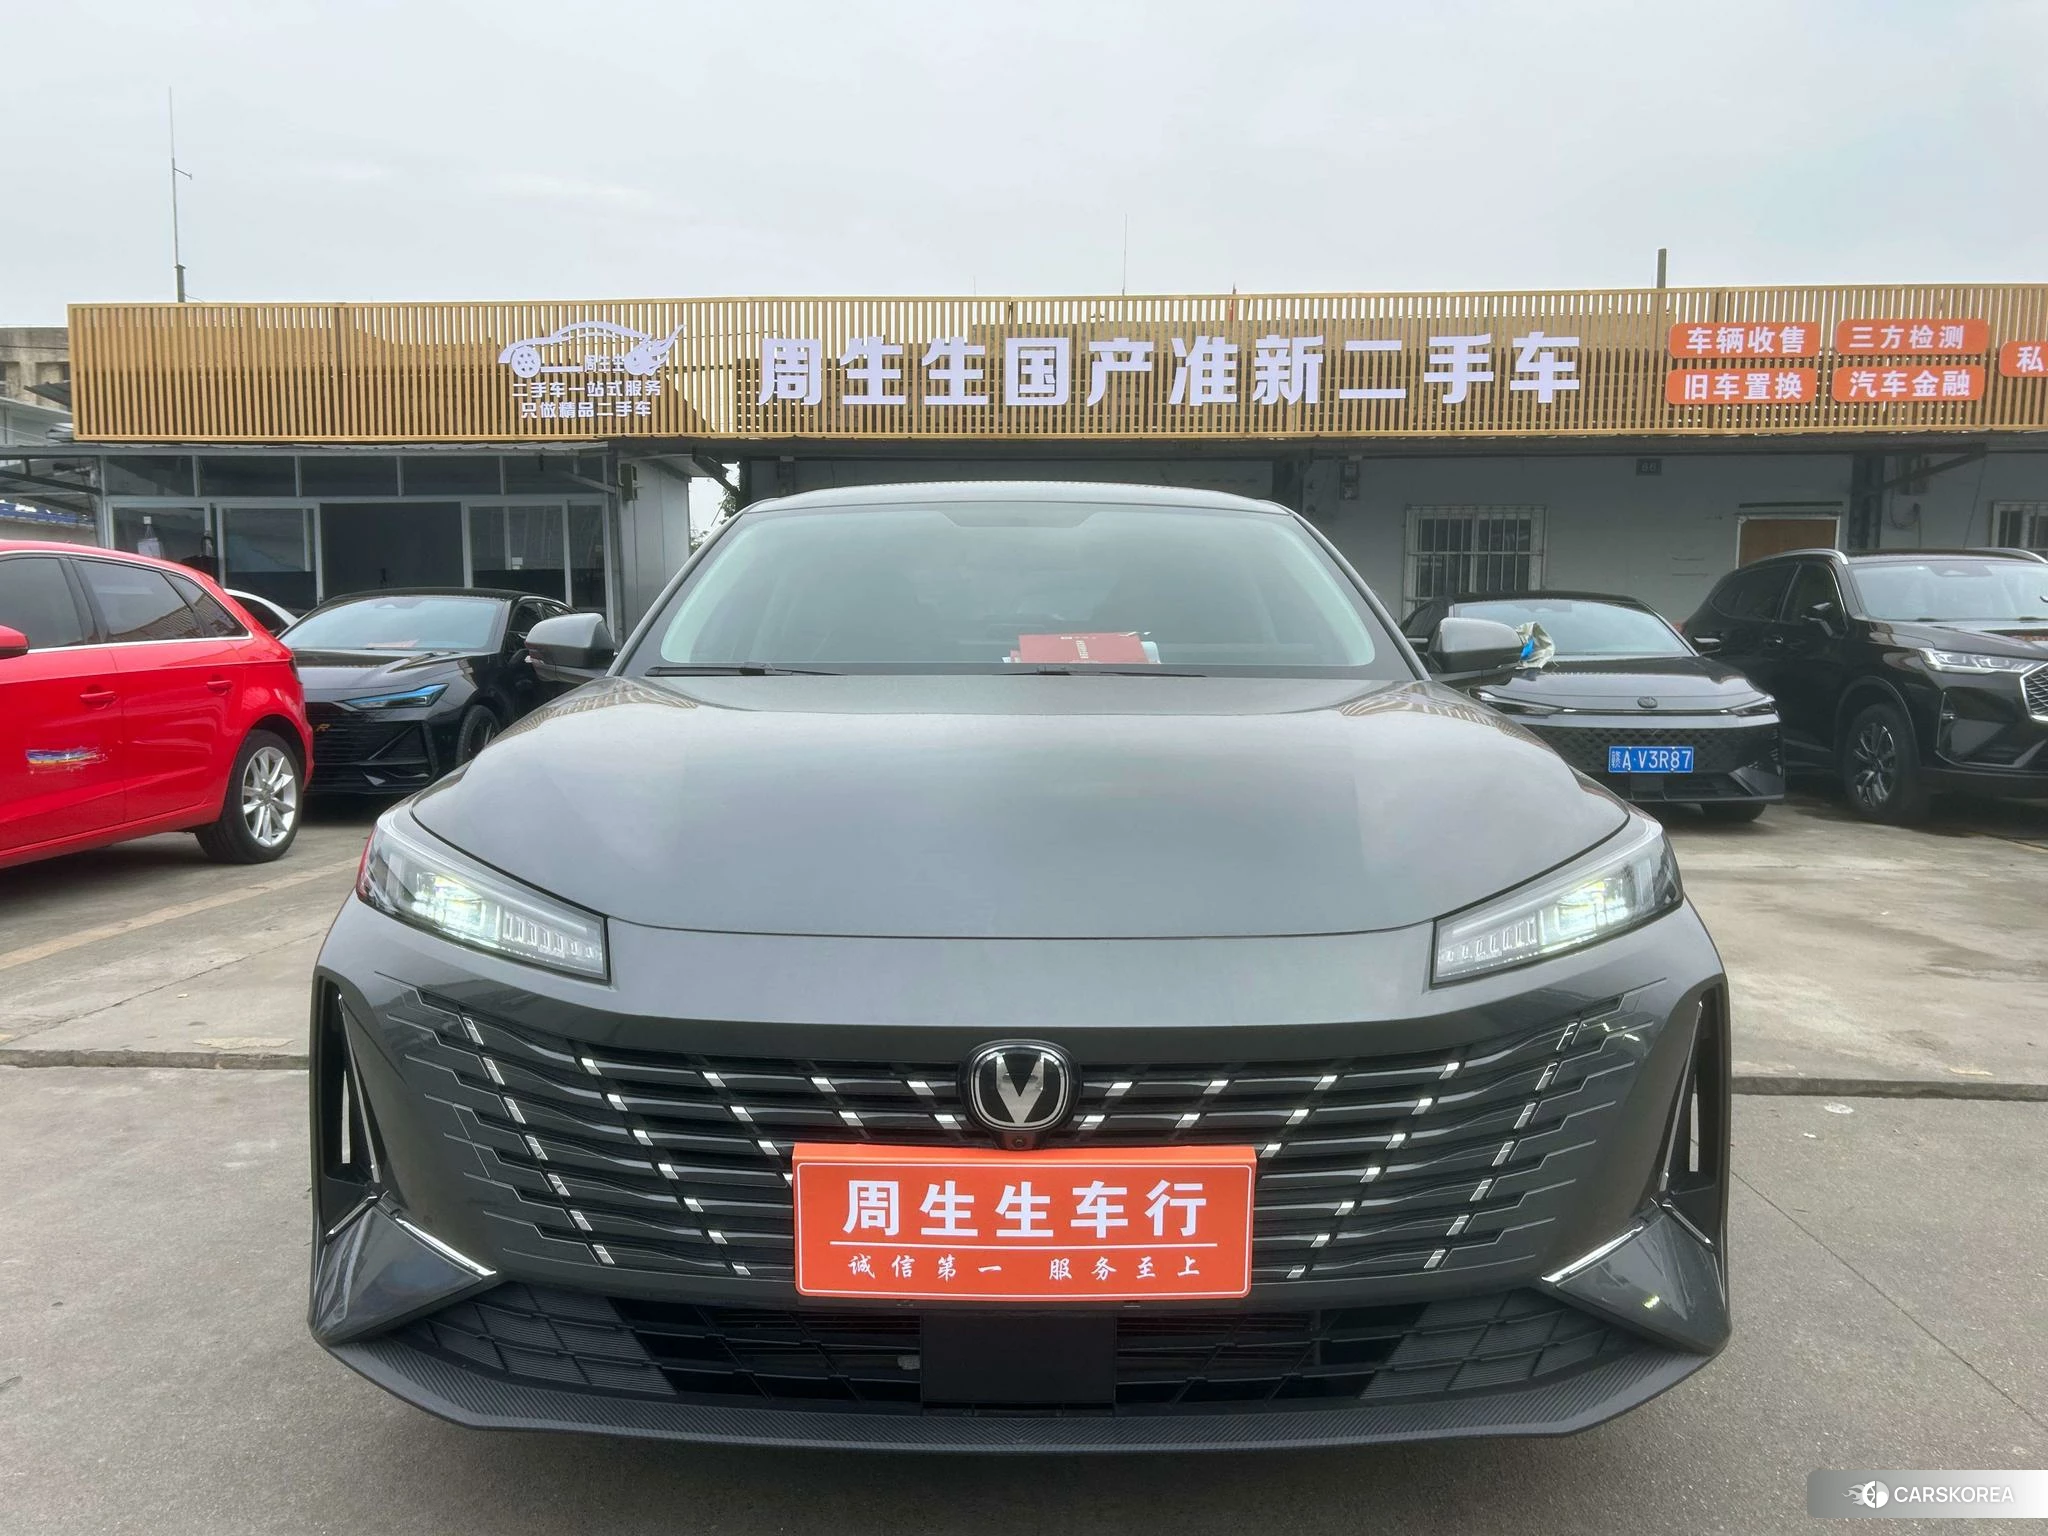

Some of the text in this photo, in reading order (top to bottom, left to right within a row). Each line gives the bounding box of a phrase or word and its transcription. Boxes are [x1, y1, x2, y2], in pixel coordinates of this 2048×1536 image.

[1686, 325, 1806, 355] 车辆收售
[1848, 324, 1964, 351] 三方检测
[759, 331, 1580, 407] 周生生国产准新二手车
[512, 380, 661, 398] 二手车一站式服务
[1684, 373, 1803, 400] 旧车置换
[1849, 369, 1971, 398] 汽车金融
[521, 401, 652, 419] 只做精品二手车
[842, 1179, 1207, 1239] 周生生车行
[847, 1253, 1201, 1280] 诚信第一 服务至上
